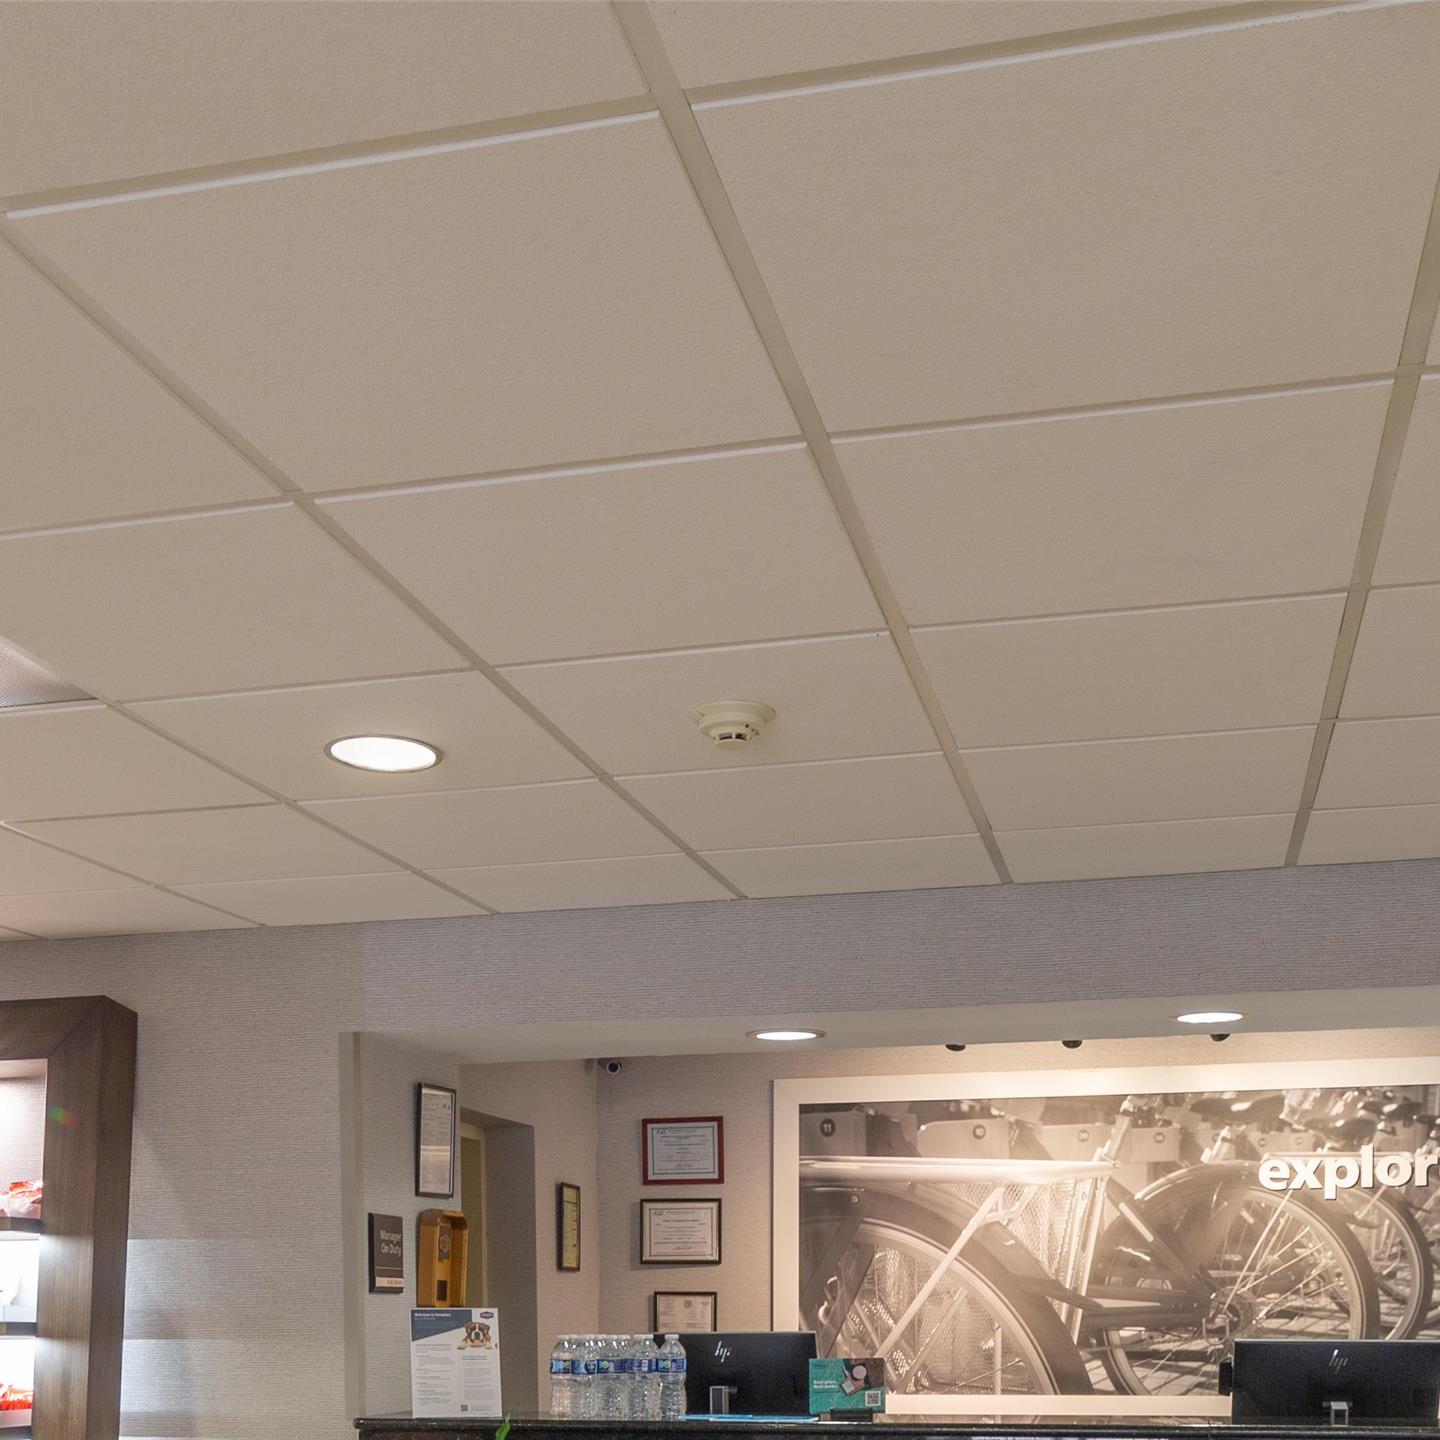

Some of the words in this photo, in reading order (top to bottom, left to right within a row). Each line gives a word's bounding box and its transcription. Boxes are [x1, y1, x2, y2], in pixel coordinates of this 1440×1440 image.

[380, 1229, 402, 1244] Manager
[381, 1243, 389, 1253] On
[389, 1244, 402, 1257] Duty
